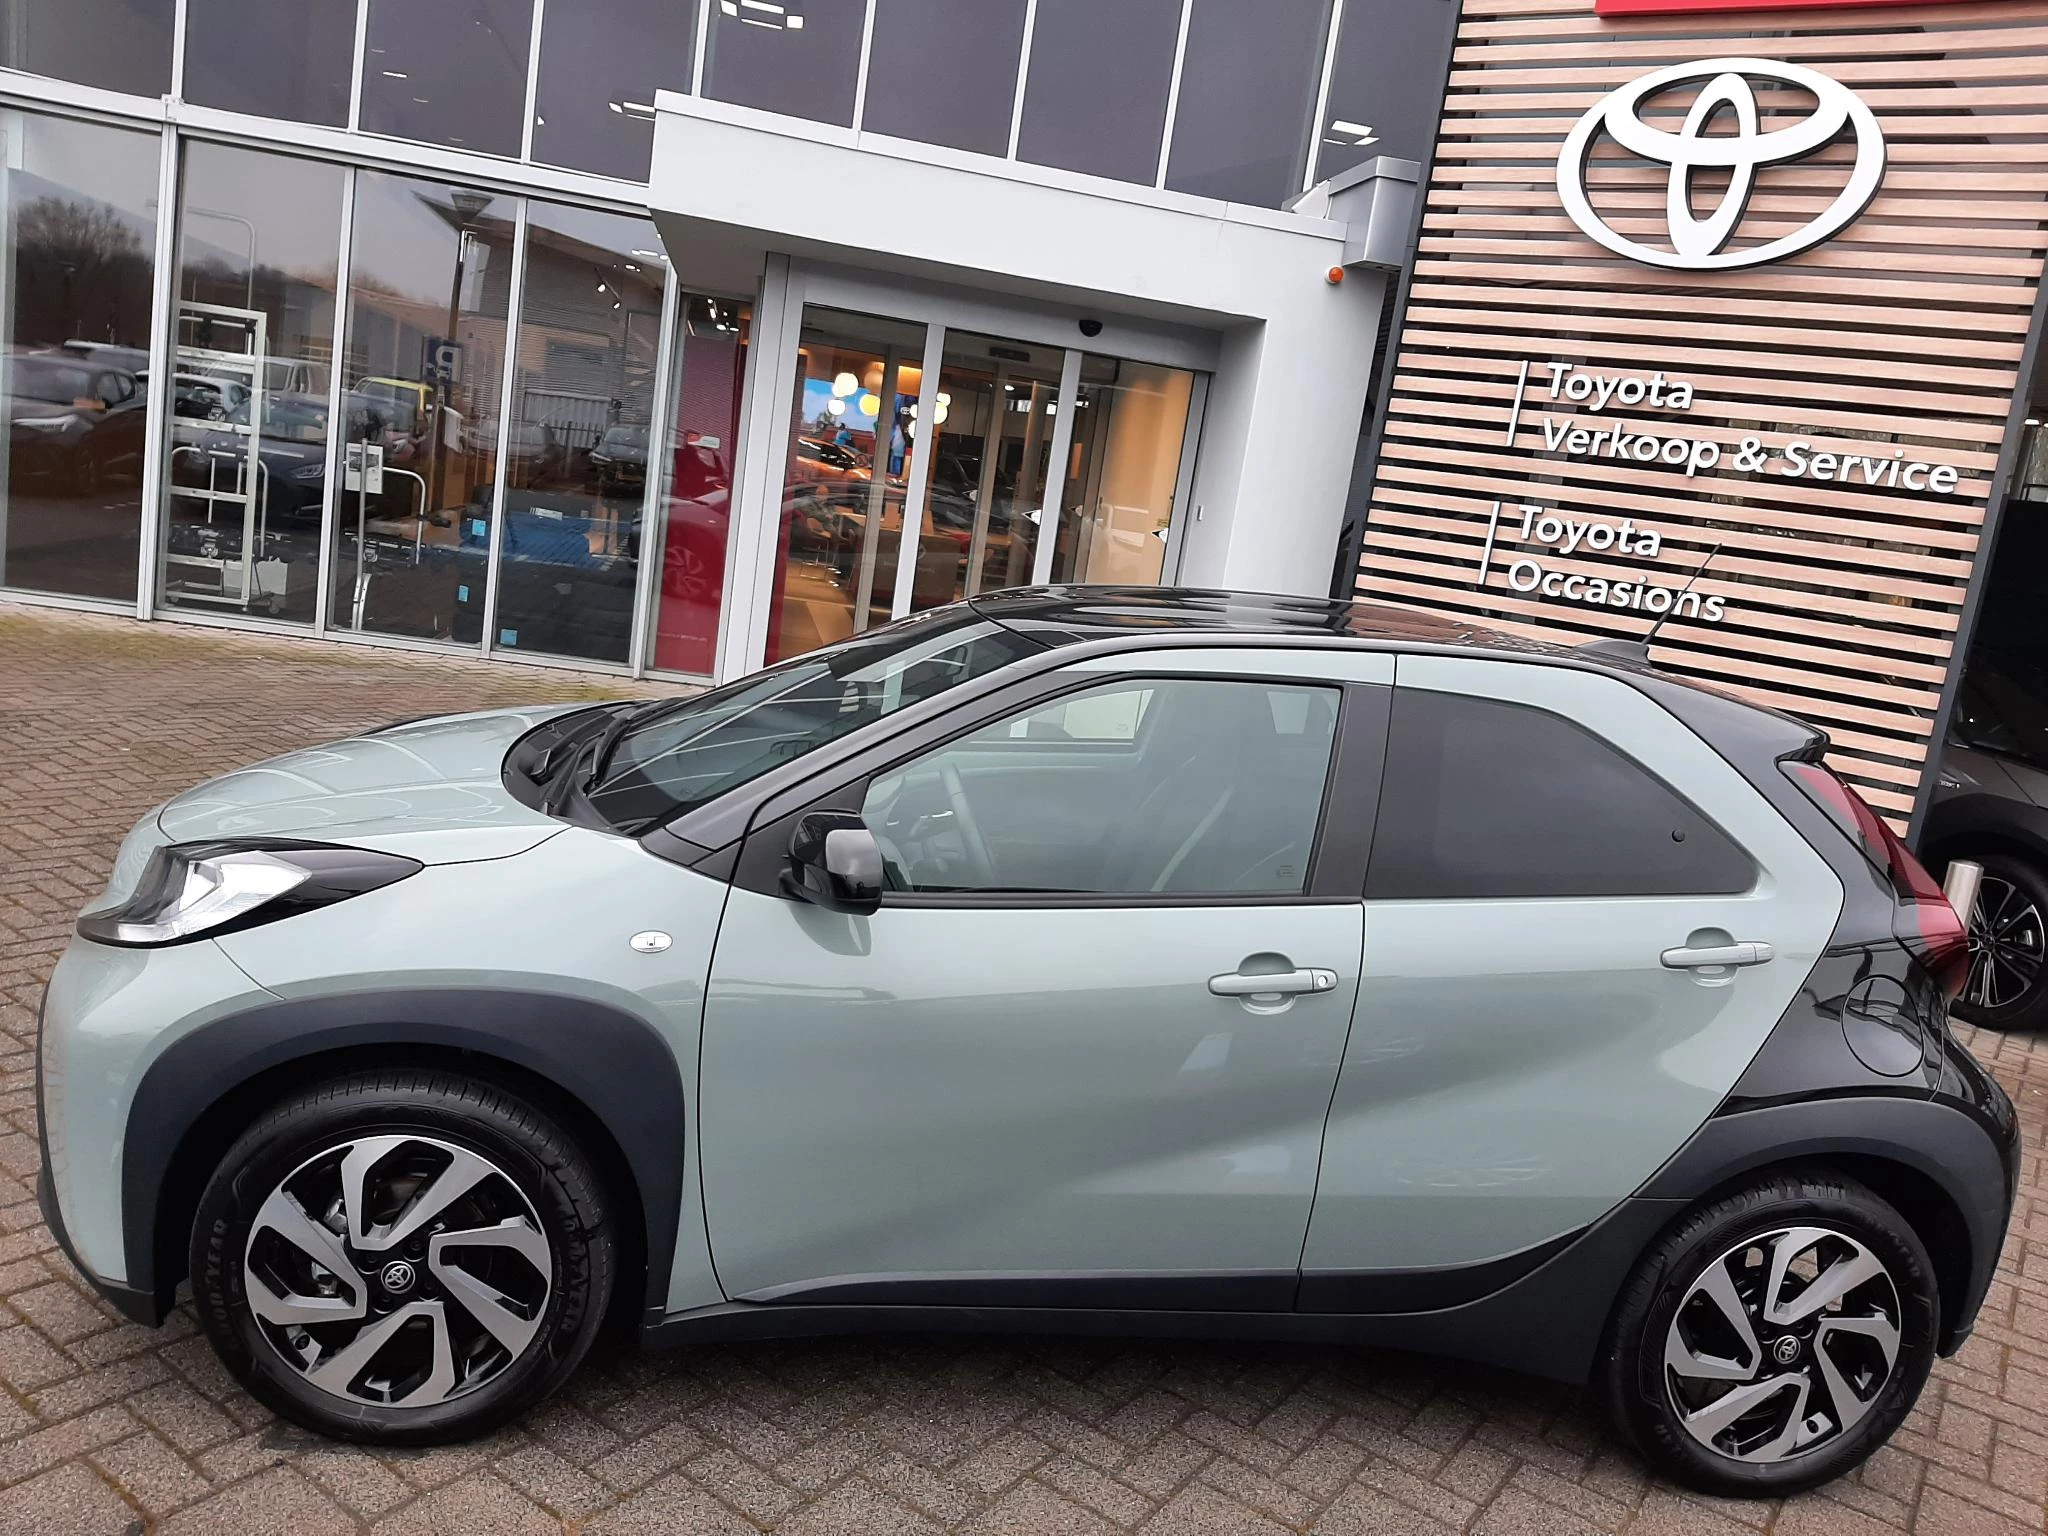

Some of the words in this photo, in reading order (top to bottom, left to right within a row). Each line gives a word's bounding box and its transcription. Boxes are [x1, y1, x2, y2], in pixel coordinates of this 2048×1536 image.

[1547, 361, 1694, 411] Toyota
[1543, 418, 1721, 477] Verkoop
[1732, 436, 1769, 474] &
[1781, 441, 1959, 494] Service
[1519, 504, 1662, 557] Toyota
[1508, 559, 1726, 622] Occasions
